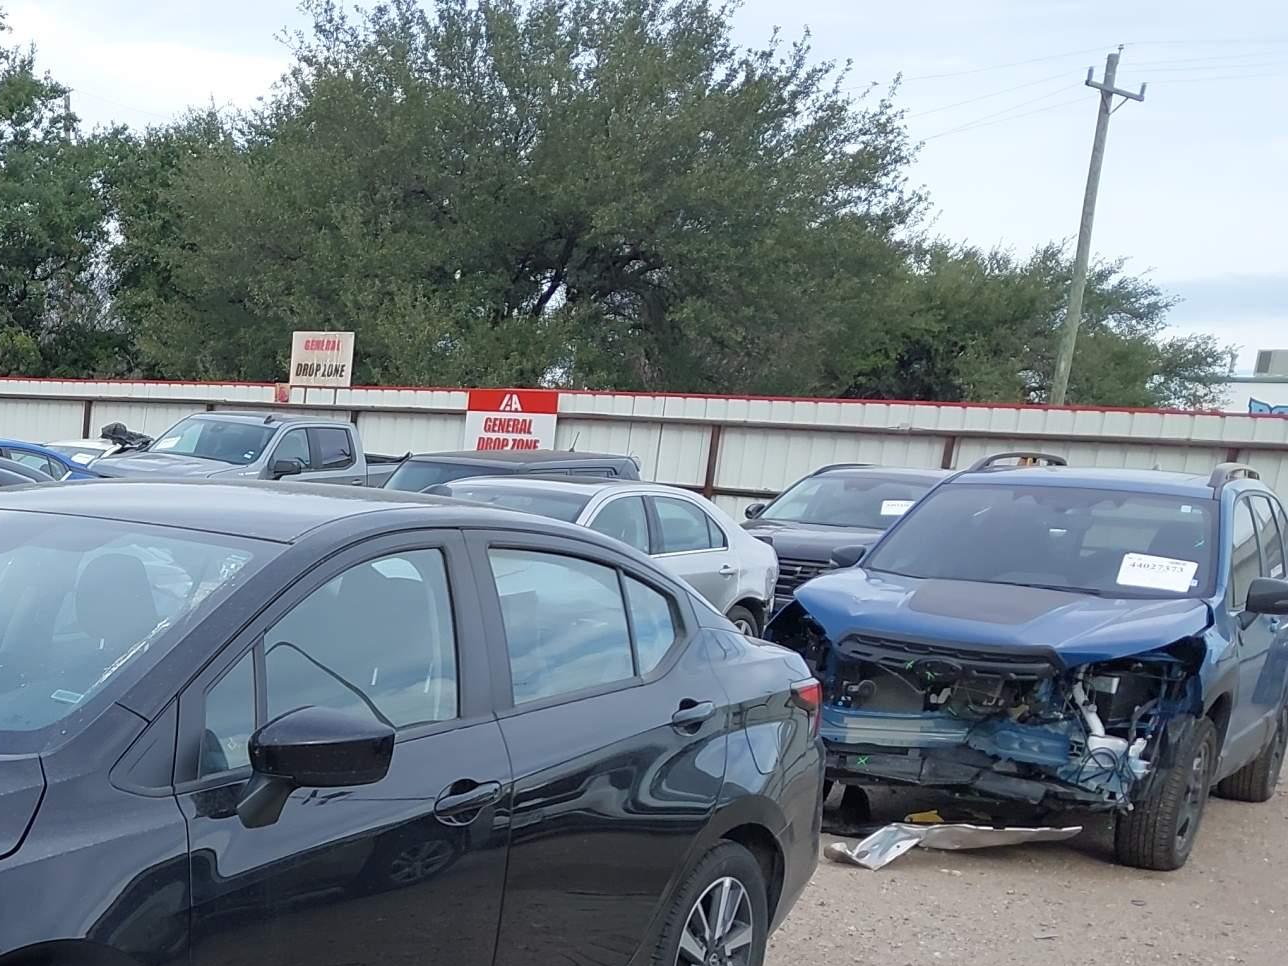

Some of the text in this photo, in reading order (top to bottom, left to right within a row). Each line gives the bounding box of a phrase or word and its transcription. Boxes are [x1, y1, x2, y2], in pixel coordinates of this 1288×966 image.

[304, 339, 340, 351] GENERAL
[295, 363, 346, 378] DROP ZONE
[483, 417, 533, 434] GENERAL
[477, 436, 509, 450] DROP
